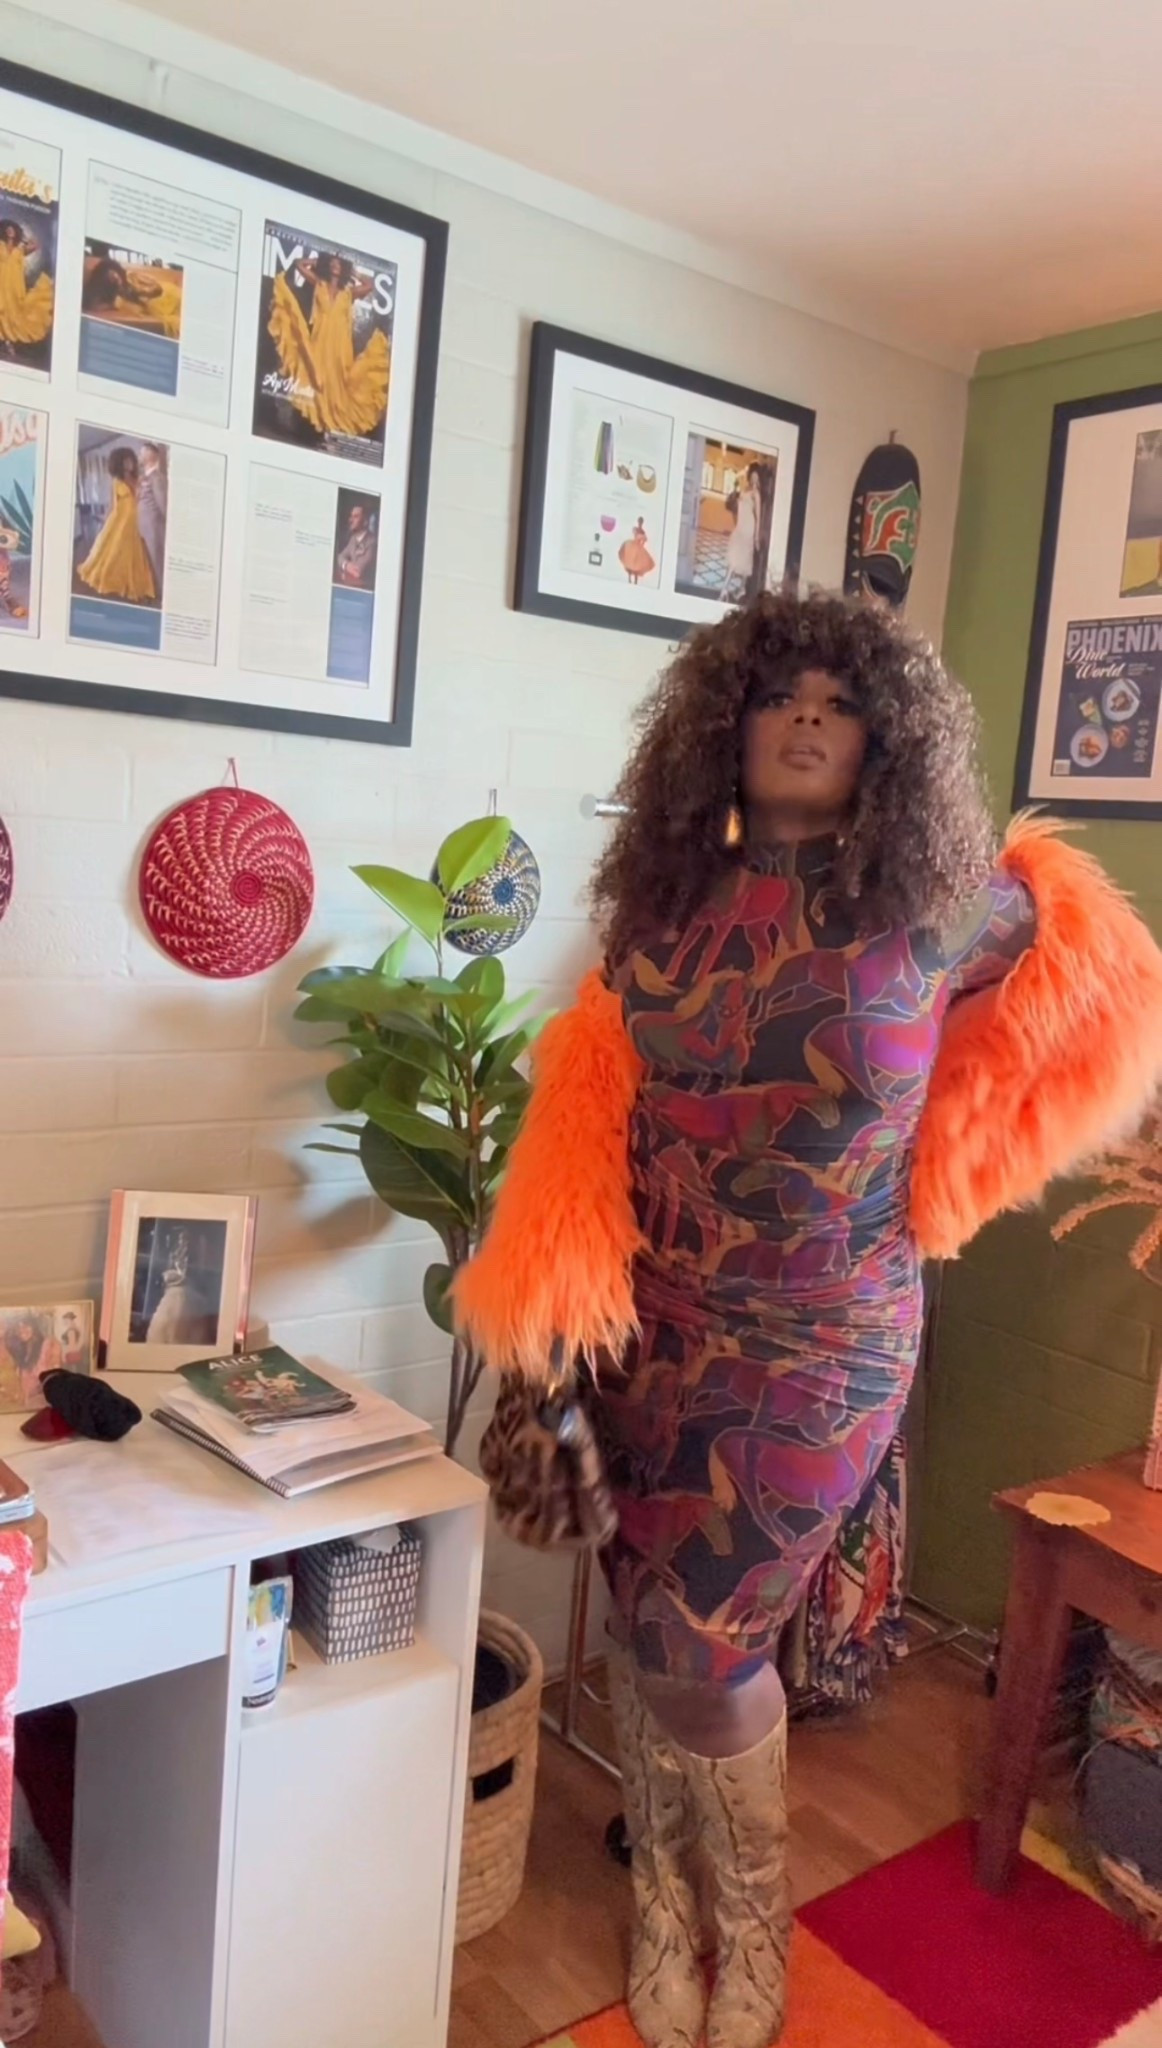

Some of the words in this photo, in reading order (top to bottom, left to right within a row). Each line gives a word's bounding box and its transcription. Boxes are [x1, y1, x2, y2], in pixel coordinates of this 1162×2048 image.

[1066, 624, 1162, 657] PHOENIX
[1075, 661, 1127, 680] World
[208, 1354, 263, 1371] ALICE
